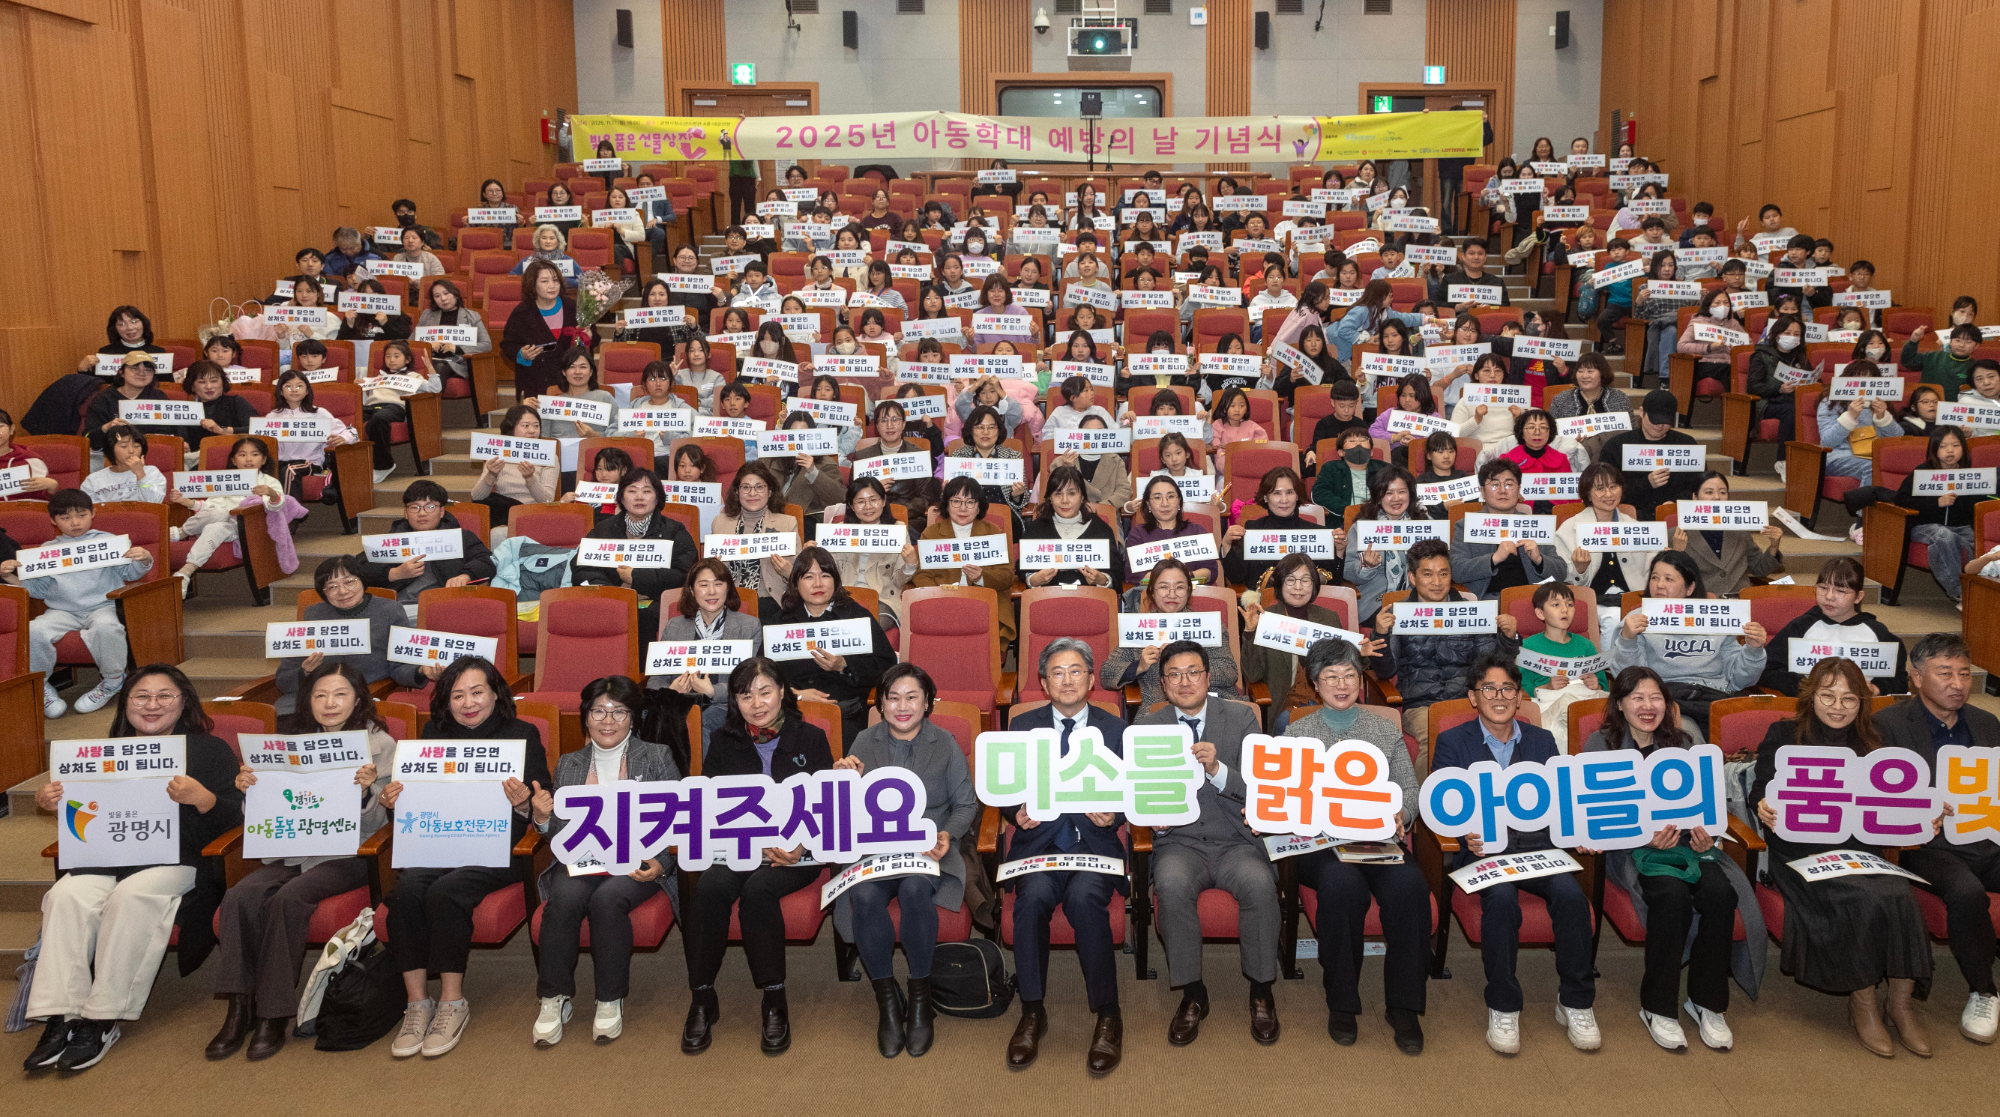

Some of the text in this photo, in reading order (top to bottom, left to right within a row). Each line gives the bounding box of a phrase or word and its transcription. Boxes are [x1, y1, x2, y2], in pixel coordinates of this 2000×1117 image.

[615, 134, 636, 152] 품은
[776, 120, 1281, 156] 2025년 아동학대 예방의 날 기념식
[487, 437, 539, 451] 사랑을 담으면
[475, 445, 550, 461] 상처도 빛이 됩니다.
[1639, 448, 1690, 456] 사랑을 담으면
[188, 473, 240, 483] 사랑을 담으면
[1930, 472, 1981, 481] 사랑을 담으면
[178, 482, 252, 493] 상처도 빛이 됩니다.
[1918, 482, 1943, 491] 상처도
[1946, 482, 1962, 490] 빛이
[1694, 504, 1750, 513] 사랑을 담으면
[1683, 515, 1763, 524] 상처도 빛이 됩니다.
[833, 528, 888, 536] 사랑을 담으면
[1261, 534, 1316, 542] 사랑을 담으면
[597, 543, 655, 552] 사랑을 담으면
[821, 537, 900, 546] 상처도 빛이 됩니다.
[38, 541, 107, 560] 사랑을 담으면
[1249, 544, 1328, 553] 상처도 빛이 됩니다.
[24, 550, 121, 573] 상처도 빛이 됩니다.
[583, 552, 665, 562] 상처도 빛이 됩니다.
[1413, 606, 1477, 616] 사랑을 담으면
[1662, 603, 1729, 614] 사랑을 담으면
[1399, 617, 1490, 628] 상처도 빛이 됩니다.
[1648, 616, 1745, 627] 상처도 빛이 됩니다.
[285, 624, 349, 637] 사랑을 담으면
[271, 636, 364, 650] 상처도 빛이 됩니다.
[1664, 638, 1716, 655] UCLA
[75, 742, 161, 758] 사랑을 담으면
[261, 737, 343, 752] 사랑을 담으면
[248, 750, 364, 764] 상처도 빛이 됩니다.
[418, 746, 500, 758] 사랑을 담으면
[58, 756, 178, 774] 상처도 빛이 됩니다.
[399, 761, 516, 773] 상처도 빛이 됩니다.
[986, 740, 1194, 815] 미소를
[1252, 745, 1391, 829] 밝은
[293, 793, 319, 806] 경기도
[1430, 755, 1717, 843] 아이들의
[1777, 756, 1932, 835] 품은
[419, 811, 439, 819] 광명시
[562, 778, 926, 864] 지켜주세요
[108, 816, 171, 843] 광명시
[247, 816, 357, 840] 아동돌봄 광명센터
[419, 818, 508, 834] 아동보호전문기관
[1021, 855, 1099, 866] 사랑을 담으면
[1475, 853, 1548, 875] 사랑을 담으면
[1005, 863, 1040, 876] 상처도
[1467, 857, 1571, 887] 상처도 빛이 됩니다.
